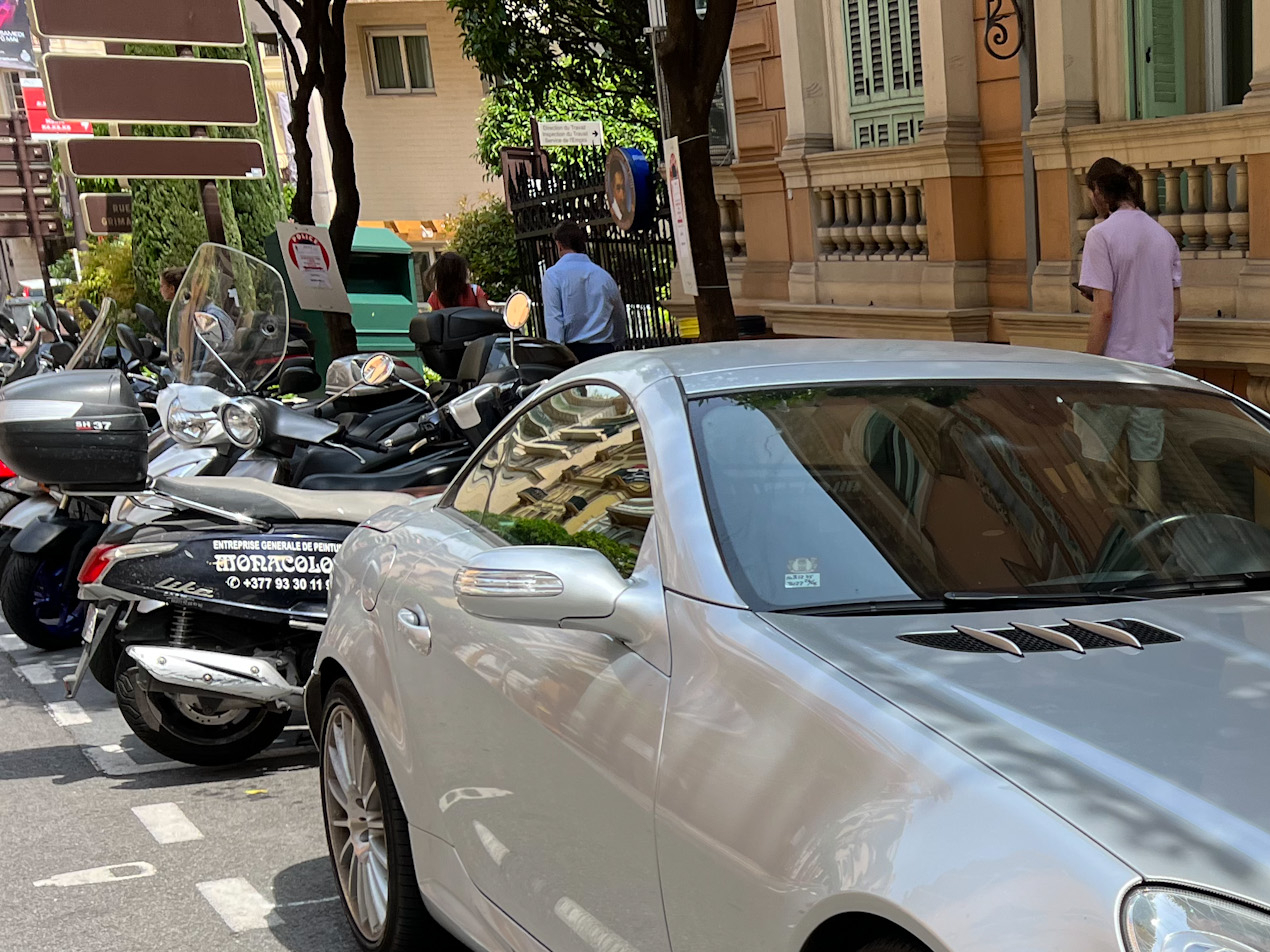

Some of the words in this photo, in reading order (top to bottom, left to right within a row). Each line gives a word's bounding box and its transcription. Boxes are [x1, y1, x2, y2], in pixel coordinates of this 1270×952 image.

[112, 203, 130, 213] RUE
[291, 232, 318, 244] POLICE
[93, 420, 112, 430] 37
[213, 540, 260, 550] ENTREPRISE
[261, 540, 301, 551] GENERALE
[302, 541, 313, 552] DE
[243, 577, 272, 590] +377
[274, 577, 291, 590] 93
[292, 577, 307, 590] 30
[309, 578, 322, 591] 11
